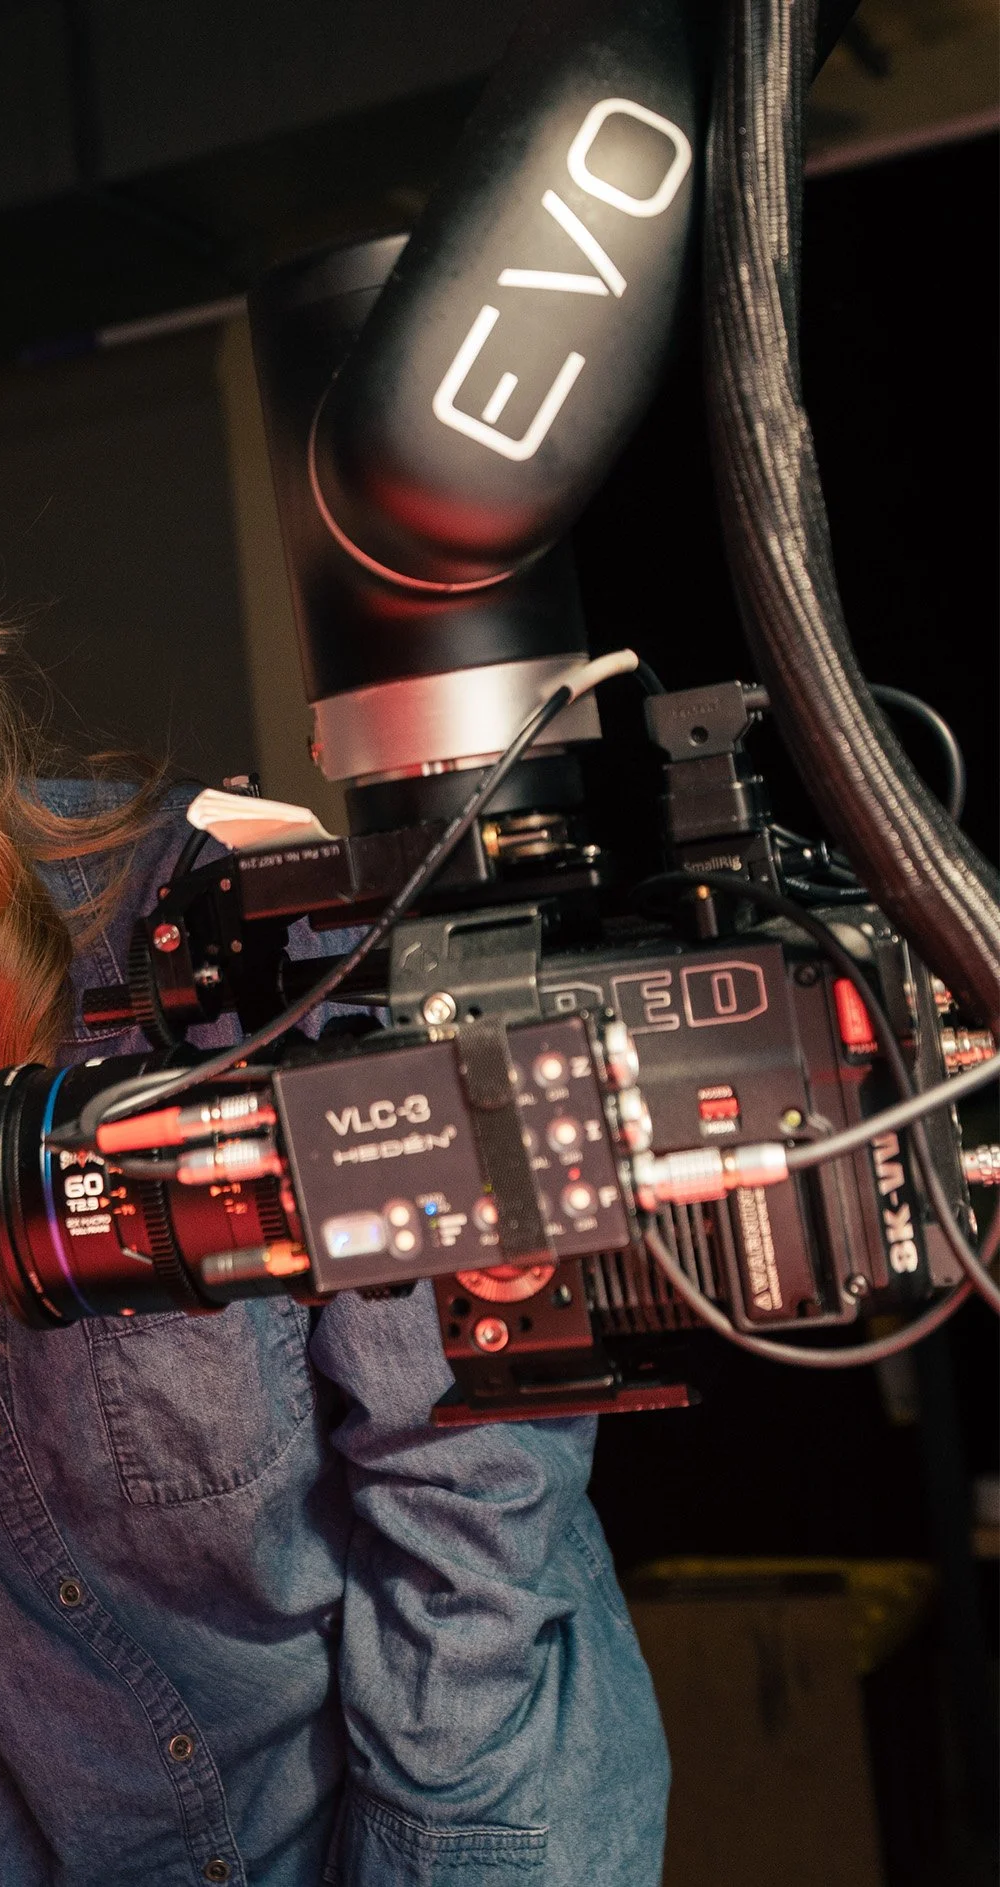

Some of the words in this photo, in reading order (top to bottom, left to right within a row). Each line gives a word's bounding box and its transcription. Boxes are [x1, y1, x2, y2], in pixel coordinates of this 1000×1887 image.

[433, 98, 692, 462] EVO
[325, 1094, 431, 1136] VLC-3
[64, 1172, 104, 1198] 60
